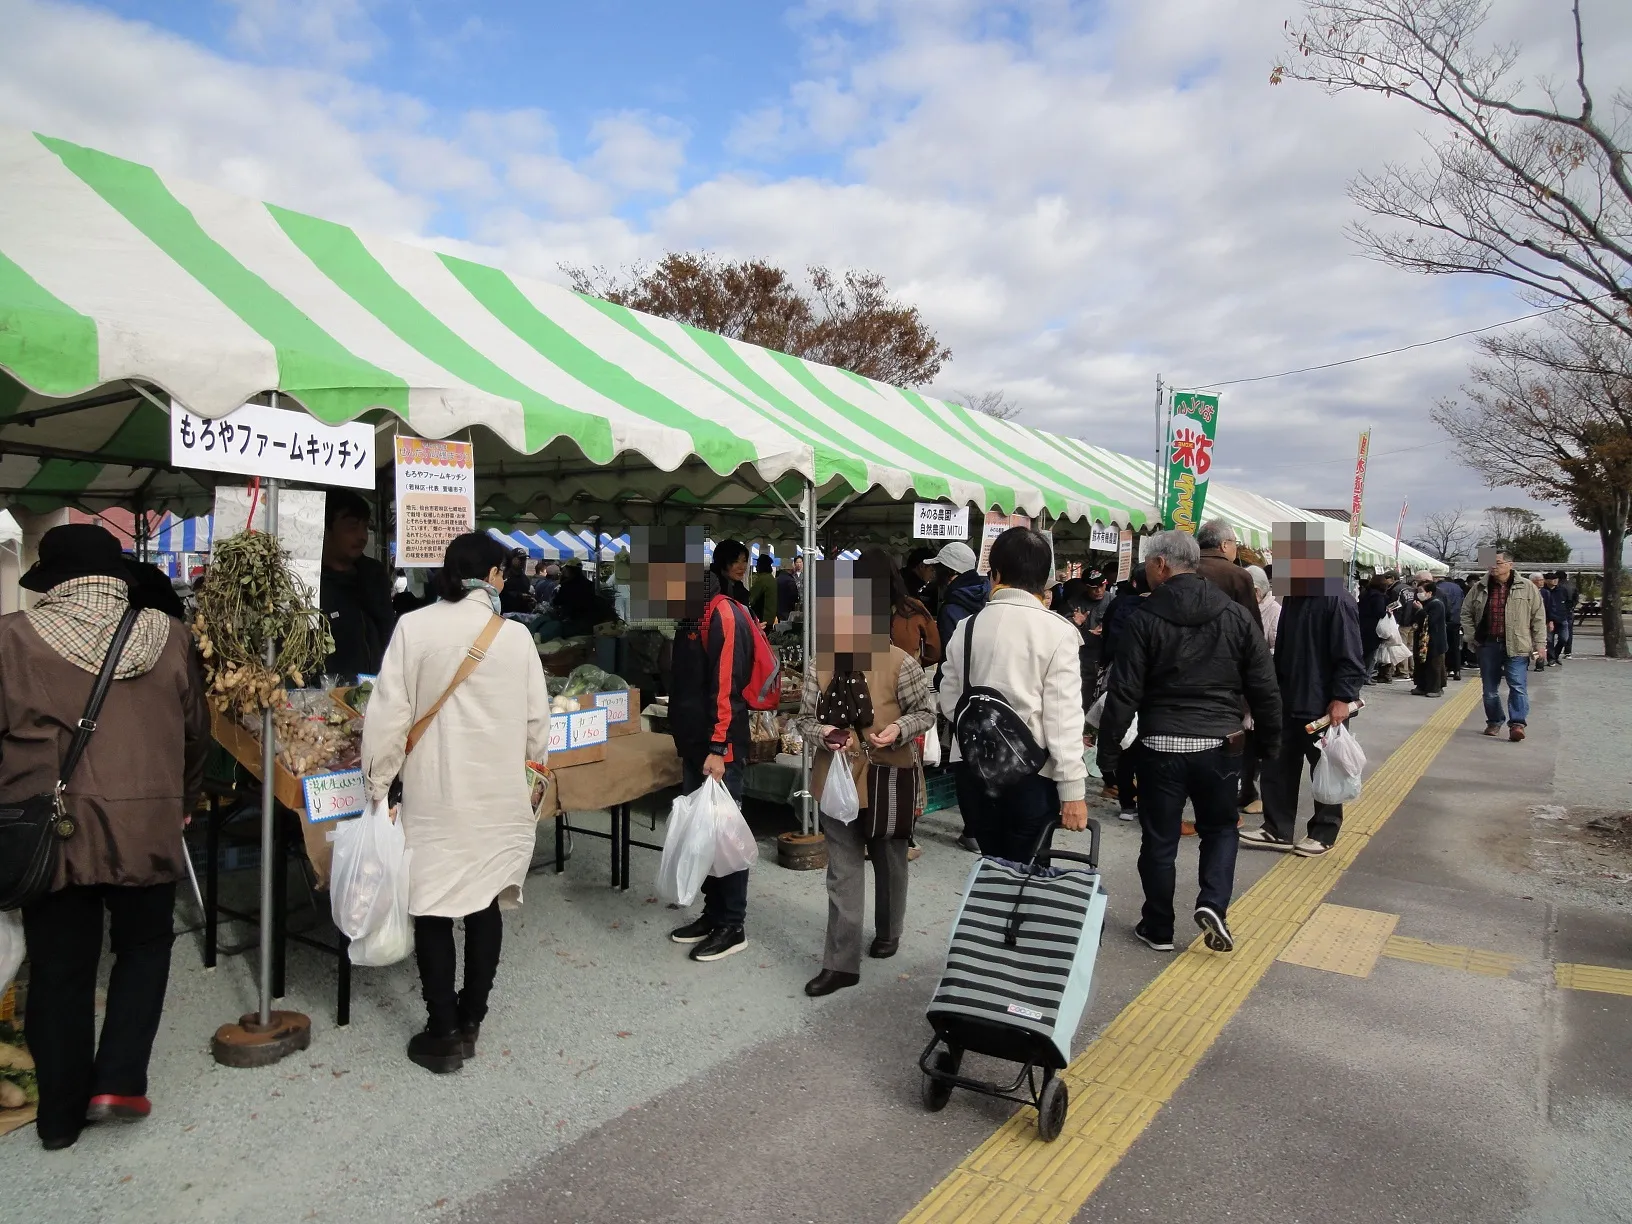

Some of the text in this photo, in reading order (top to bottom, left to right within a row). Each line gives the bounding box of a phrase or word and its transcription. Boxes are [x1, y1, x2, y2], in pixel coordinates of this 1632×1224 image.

[181, 414, 366, 470] もろやファームキッチン
[405, 470, 467, 481] もろやファームキッチン
[920, 523, 963, 537] 自然農園 MITU
